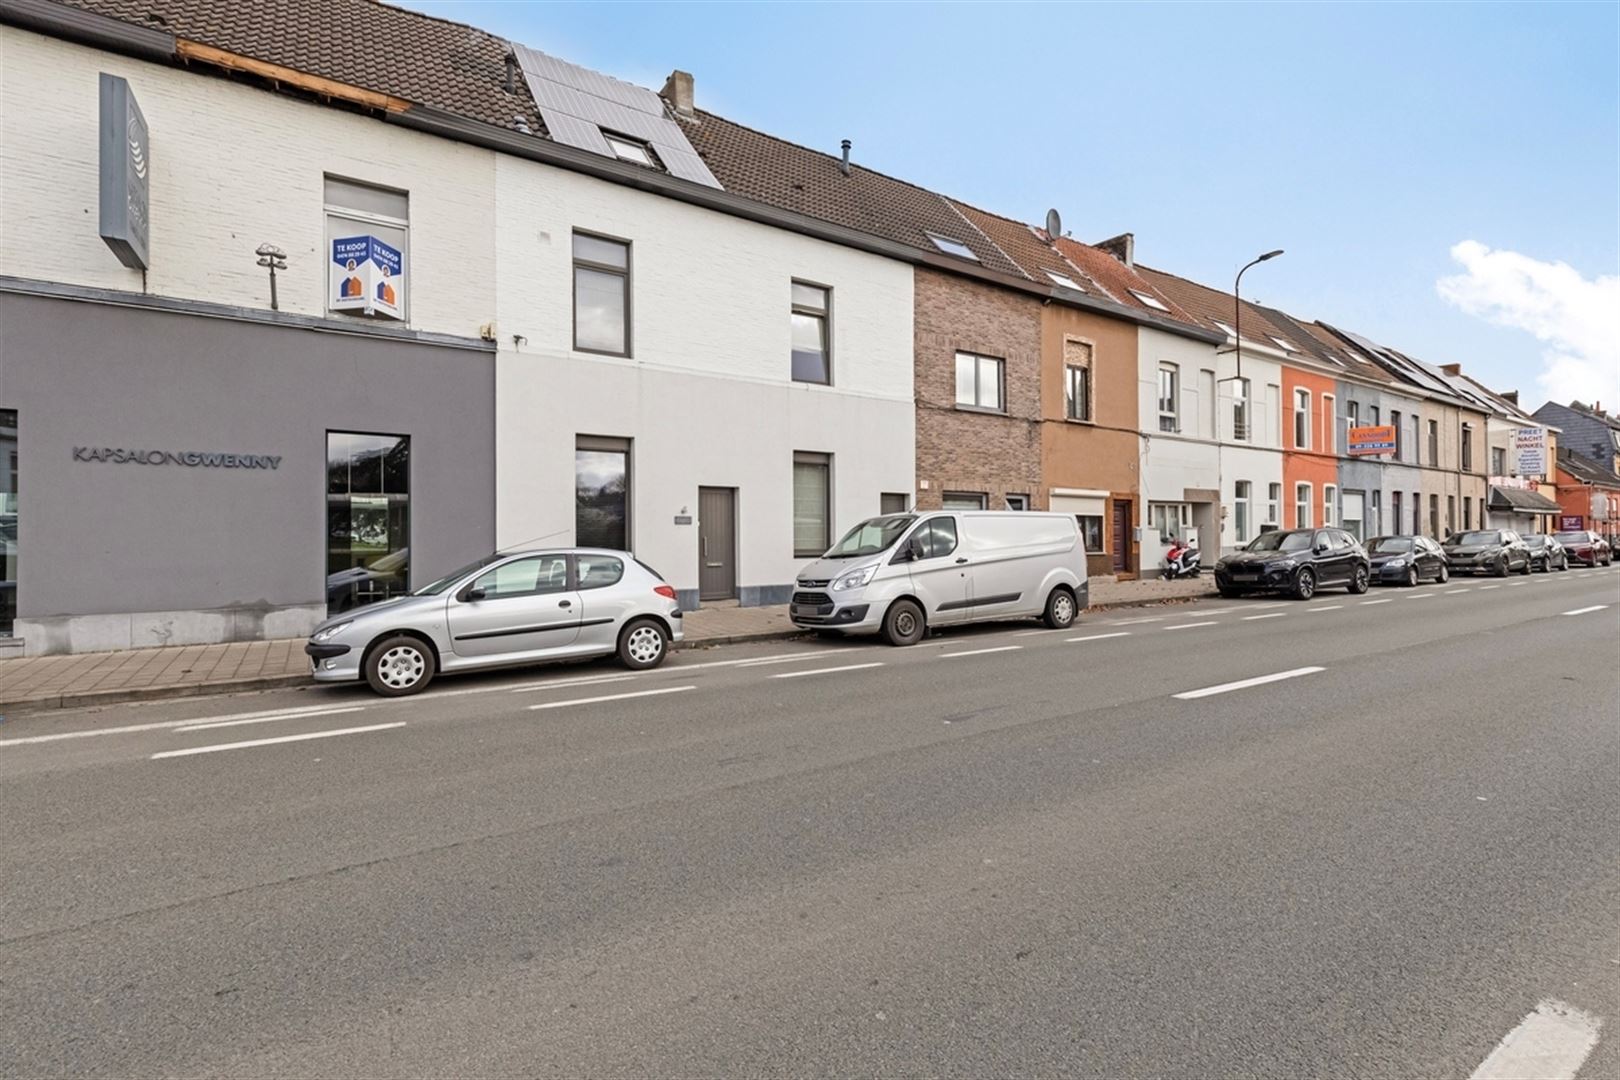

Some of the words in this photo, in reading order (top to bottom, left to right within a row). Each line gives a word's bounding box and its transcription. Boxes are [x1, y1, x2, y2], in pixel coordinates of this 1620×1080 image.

[337, 244, 345, 252] TE
[346, 242, 367, 251] KOOP
[373, 243, 381, 253] TE
[381, 247, 399, 262] KOOP
